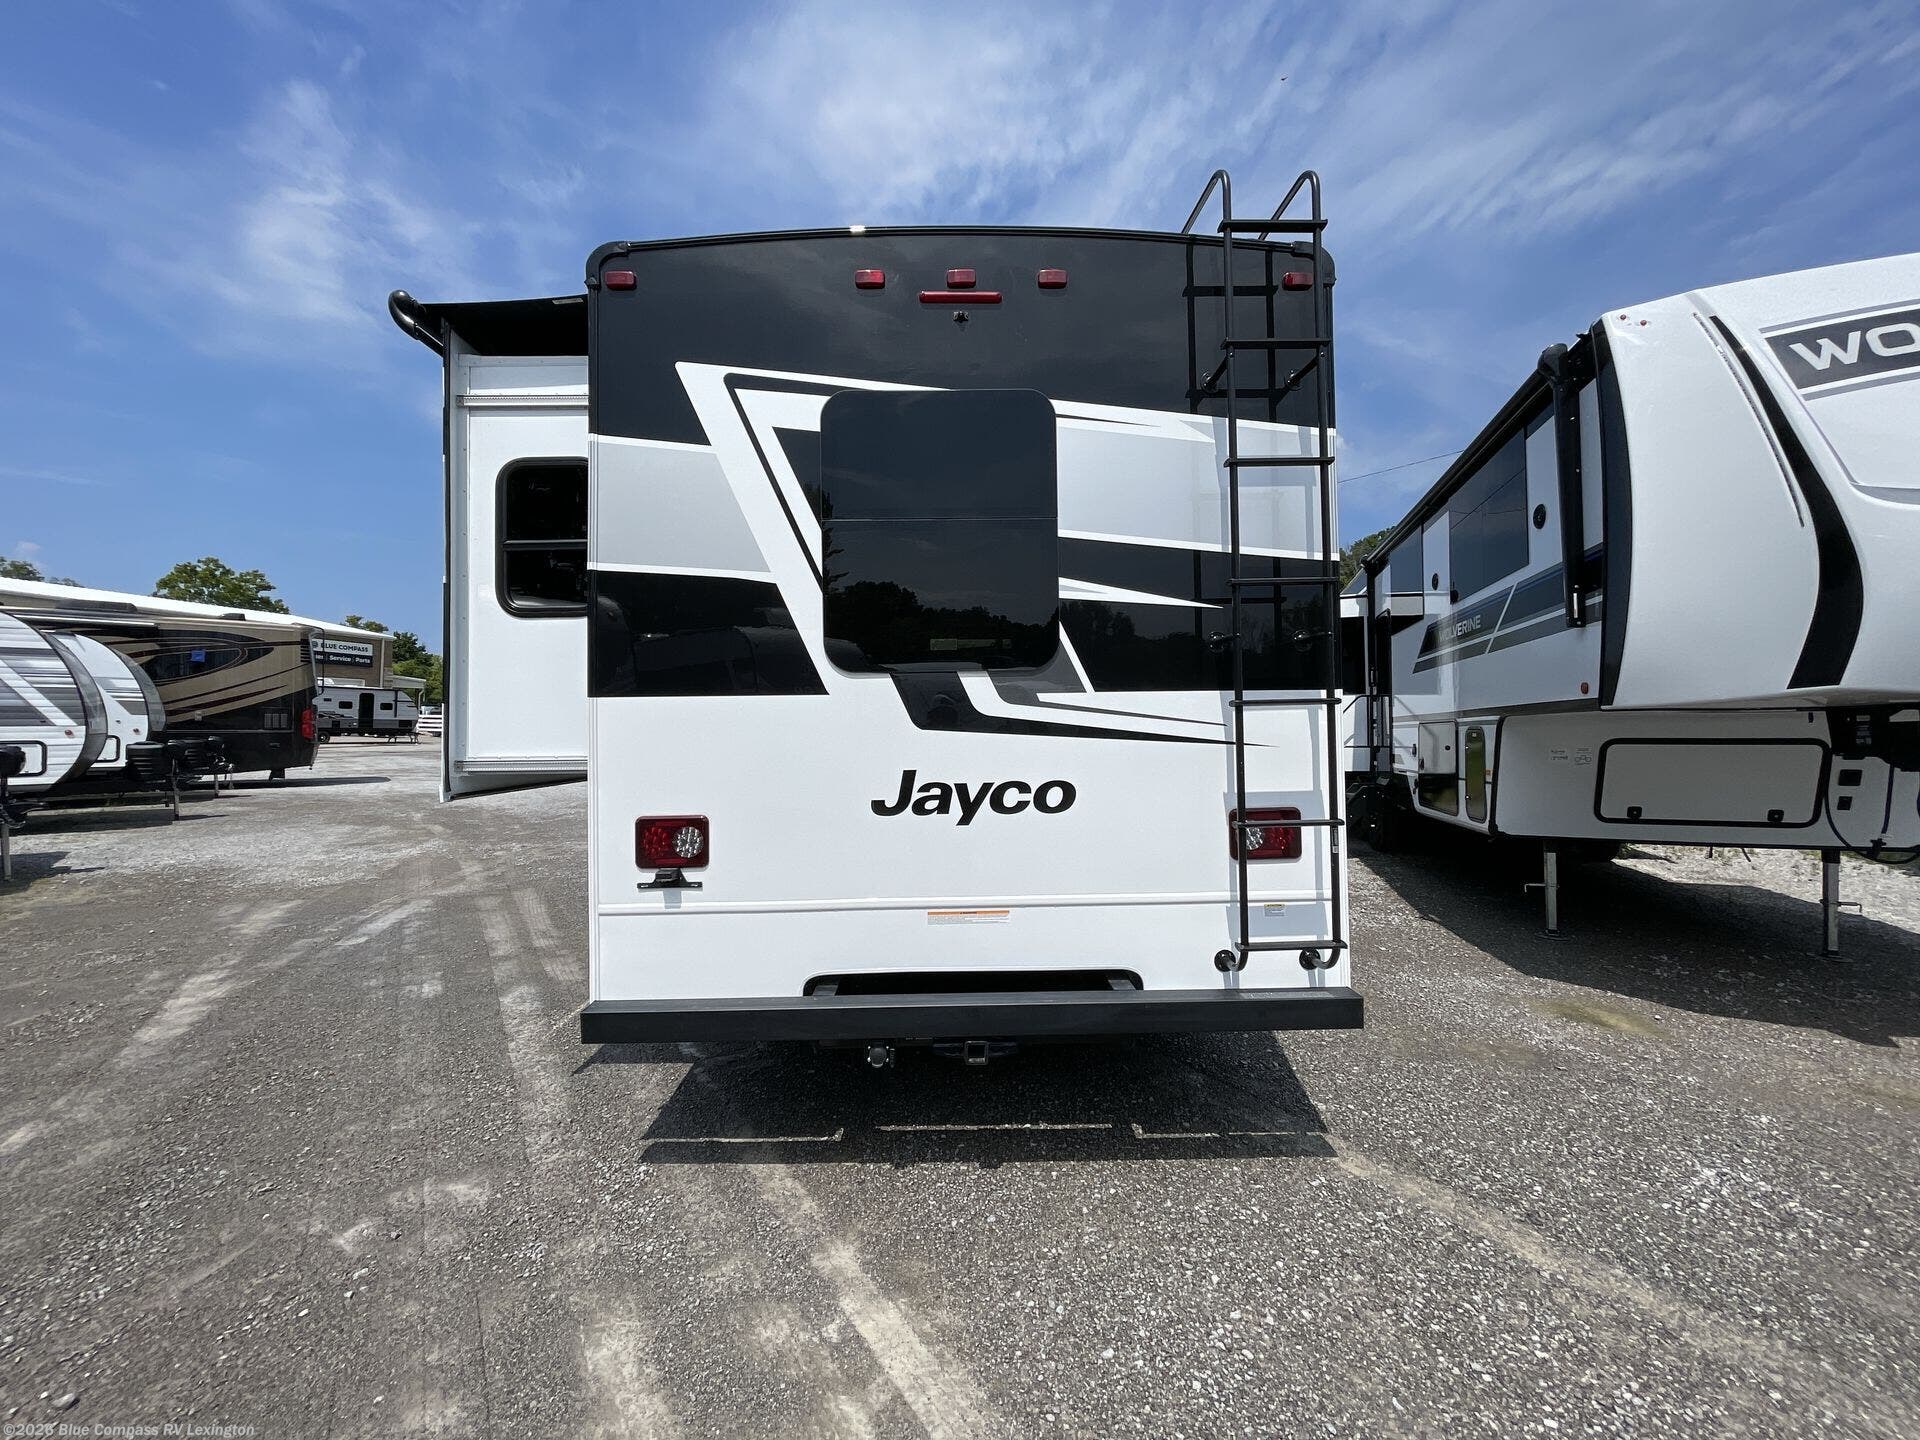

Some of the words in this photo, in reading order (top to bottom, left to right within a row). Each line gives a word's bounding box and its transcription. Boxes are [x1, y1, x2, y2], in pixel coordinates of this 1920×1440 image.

[338, 644, 369, 653] COMPASS
[329, 654, 352, 662] Service
[871, 769, 1077, 826] Jayco
